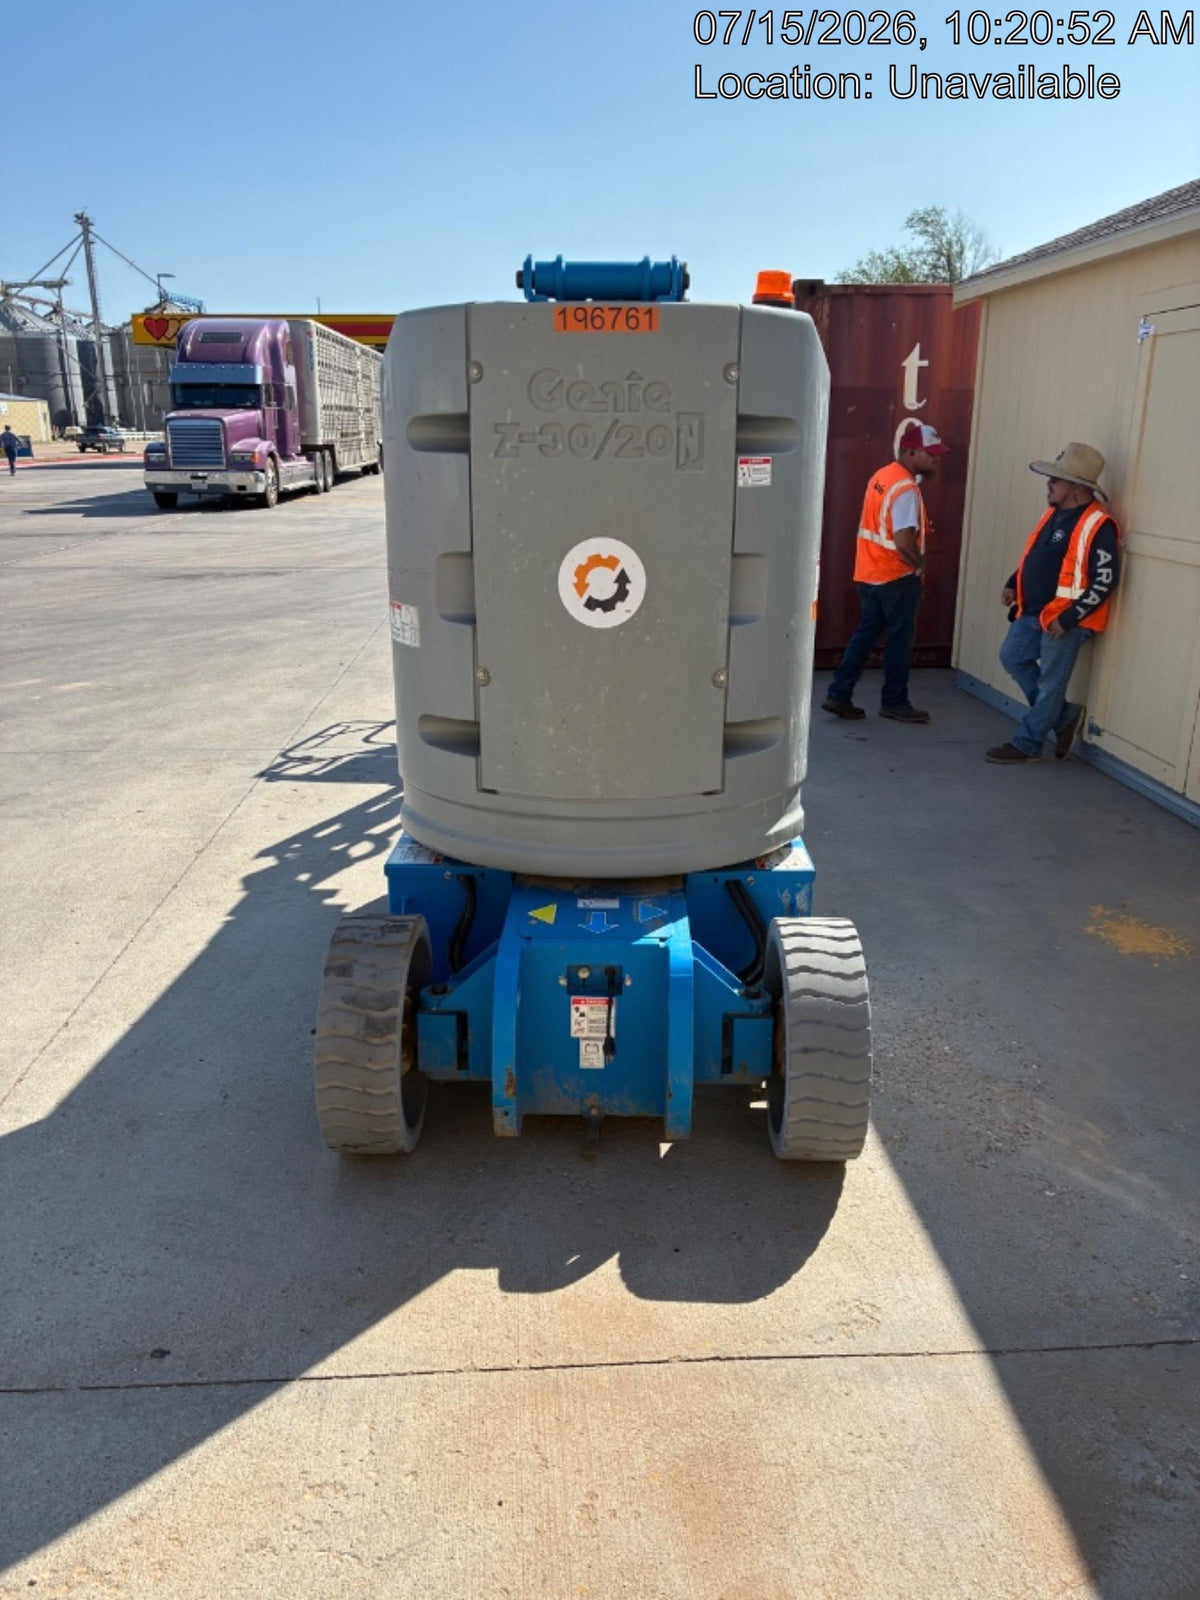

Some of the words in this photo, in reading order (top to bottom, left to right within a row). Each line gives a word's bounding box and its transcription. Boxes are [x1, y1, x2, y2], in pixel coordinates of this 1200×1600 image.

[557, 306, 654, 331] 196761
[527, 367, 672, 413] Genie
[492, 411, 705, 471] Z-30/20N
[1075, 549, 1113, 619] ARIAT
